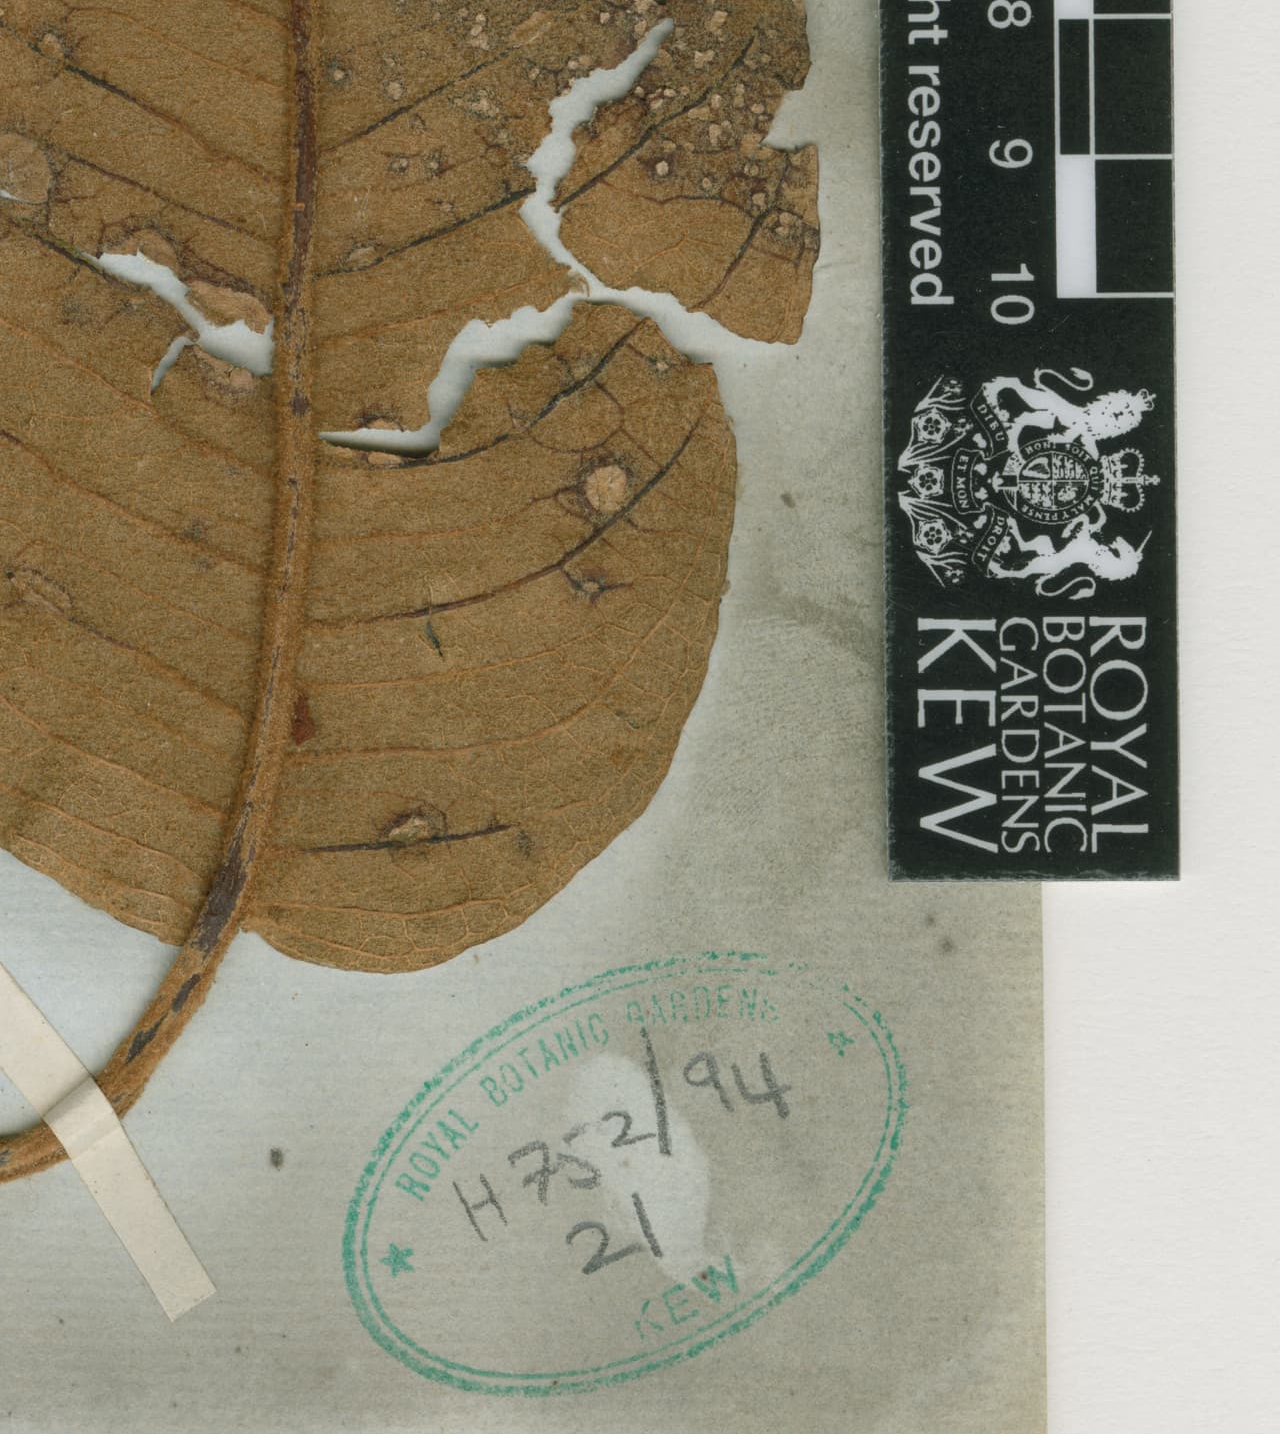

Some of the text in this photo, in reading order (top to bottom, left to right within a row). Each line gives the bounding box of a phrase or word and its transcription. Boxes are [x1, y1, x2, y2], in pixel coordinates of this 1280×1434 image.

[987, 0, 1032, 28] 8
[907, 65, 954, 305] reserved
[989, 138, 1033, 169] 9
[990, 263, 1035, 325] 10
[976, 403, 1006, 443] DIEU
[955, 453, 970, 510] ET MON
[976, 516, 1006, 563] DROIT
[916, 618, 999, 855] KEW
[999, 616, 1040, 854] GARDENS
[1042, 616, 1088, 854] BOTANIC
[1089, 617, 1149, 854] ROYAL
[394, 1108, 480, 1202] ROYAL
[477, 1014, 609, 1108] BOTANIC
[633, 1254, 740, 1339] KEW
